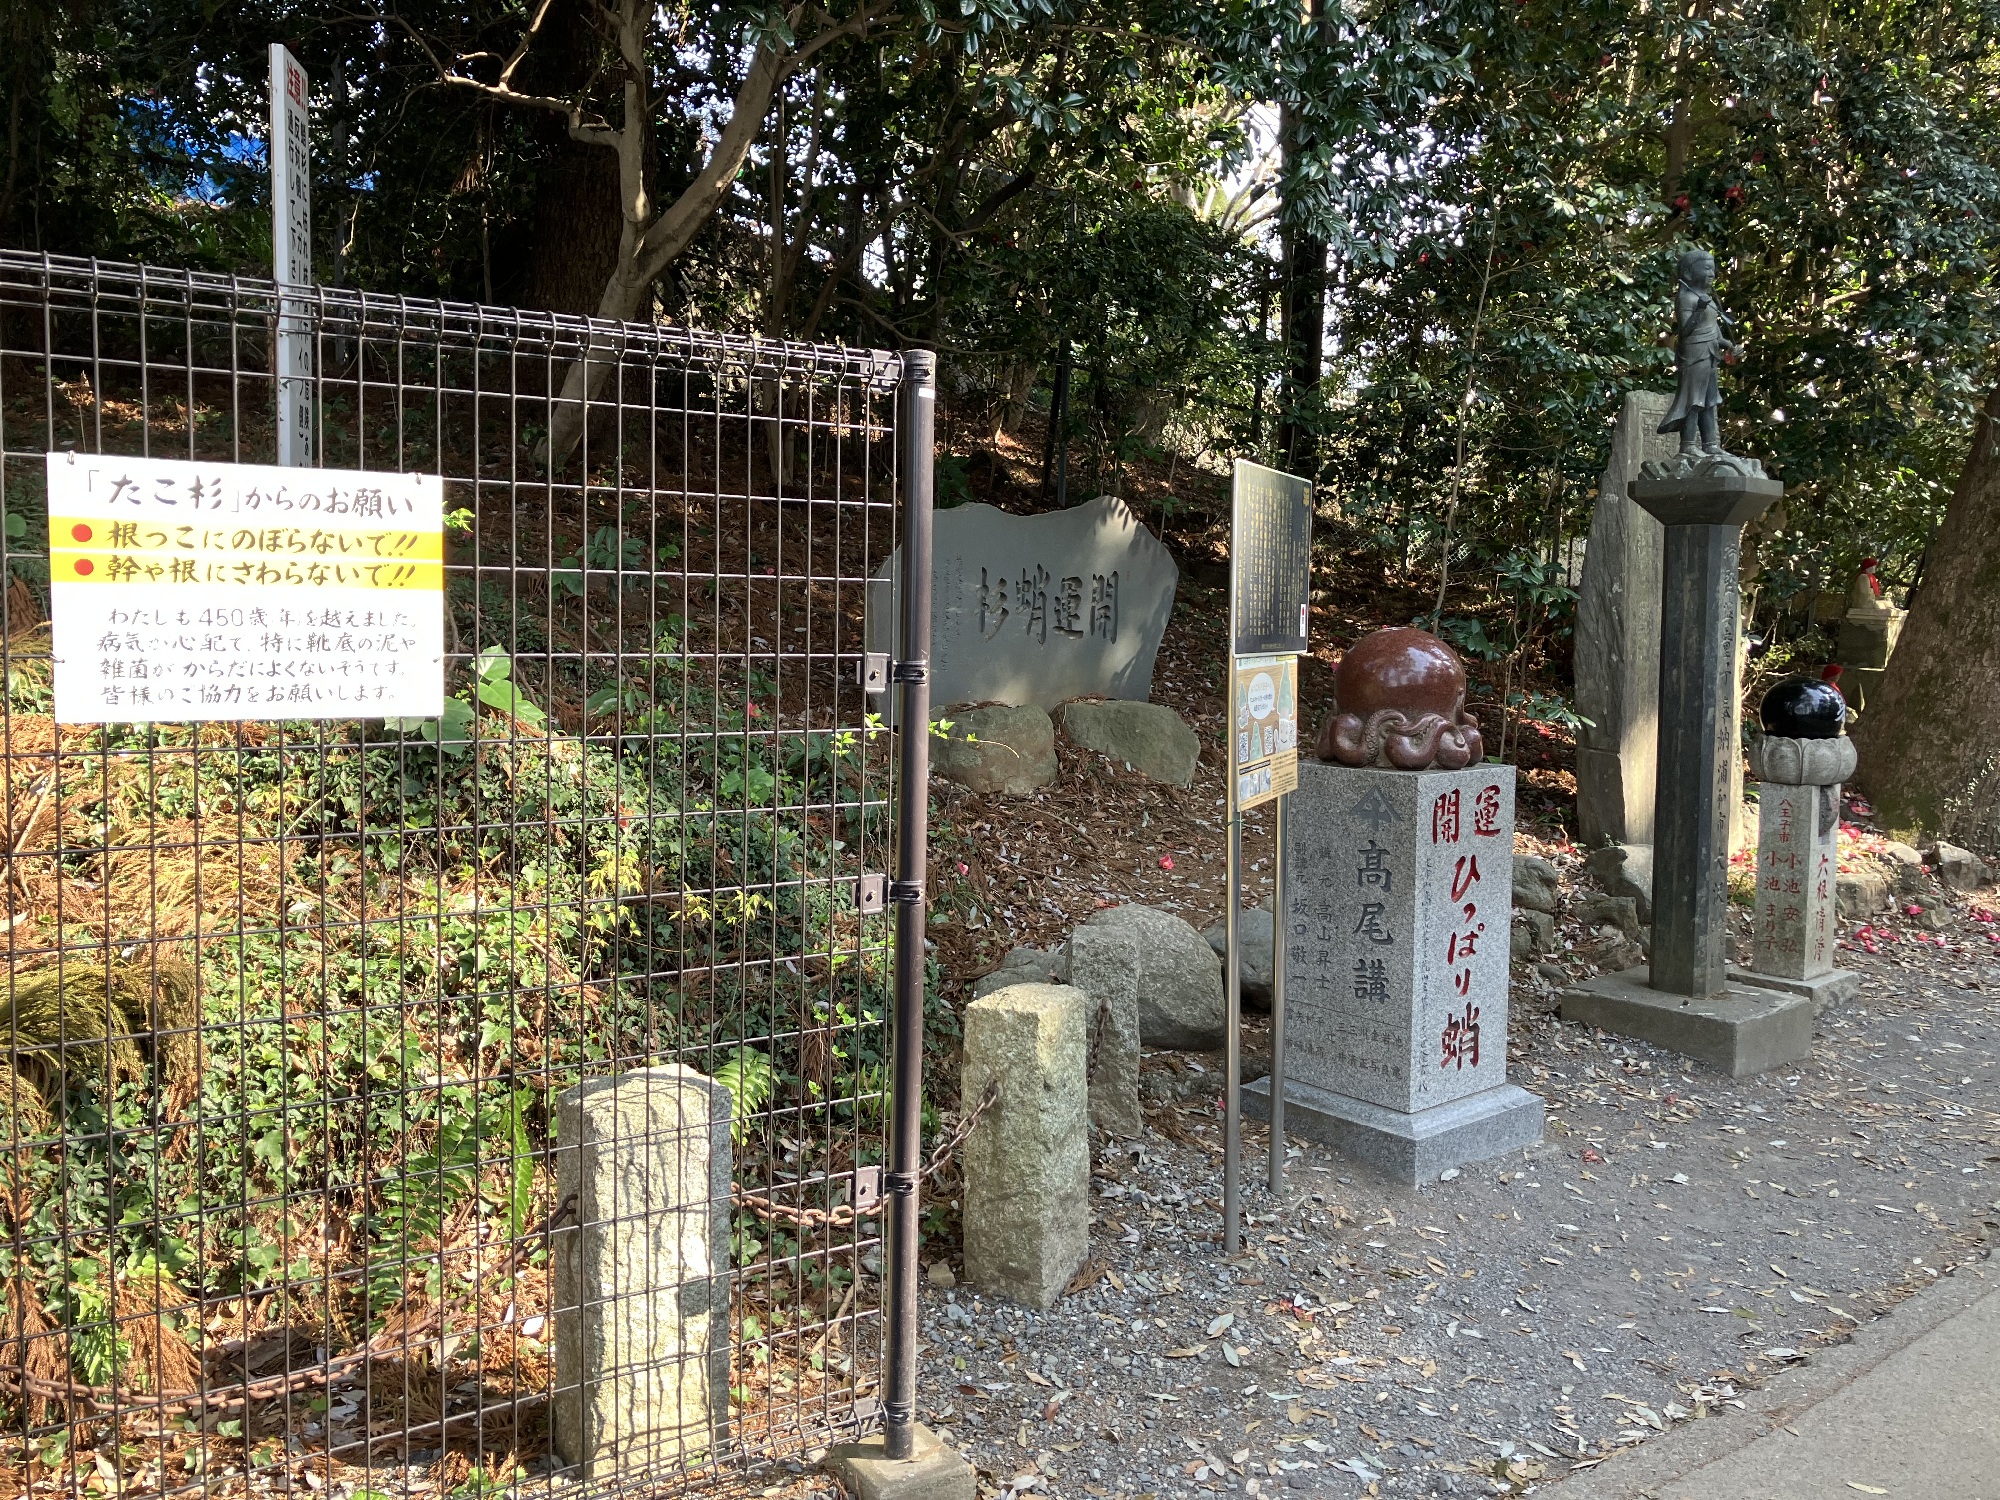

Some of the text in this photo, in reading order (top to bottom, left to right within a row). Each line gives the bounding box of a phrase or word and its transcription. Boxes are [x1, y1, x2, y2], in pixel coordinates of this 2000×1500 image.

[87, 468, 413, 520] 「たこ杉」からのお願い
[106, 520, 418, 558] 根っこにのぼらないで!!
[105, 555, 415, 587] 幹や根にさわらないで!!
[1778, 798, 1794, 844] 八王子市
[1761, 850, 1782, 952] 小池まり子
[1779, 853, 1802, 954] 小池安弘
[1441, 854, 1485, 1071] ひっぱり蛸
